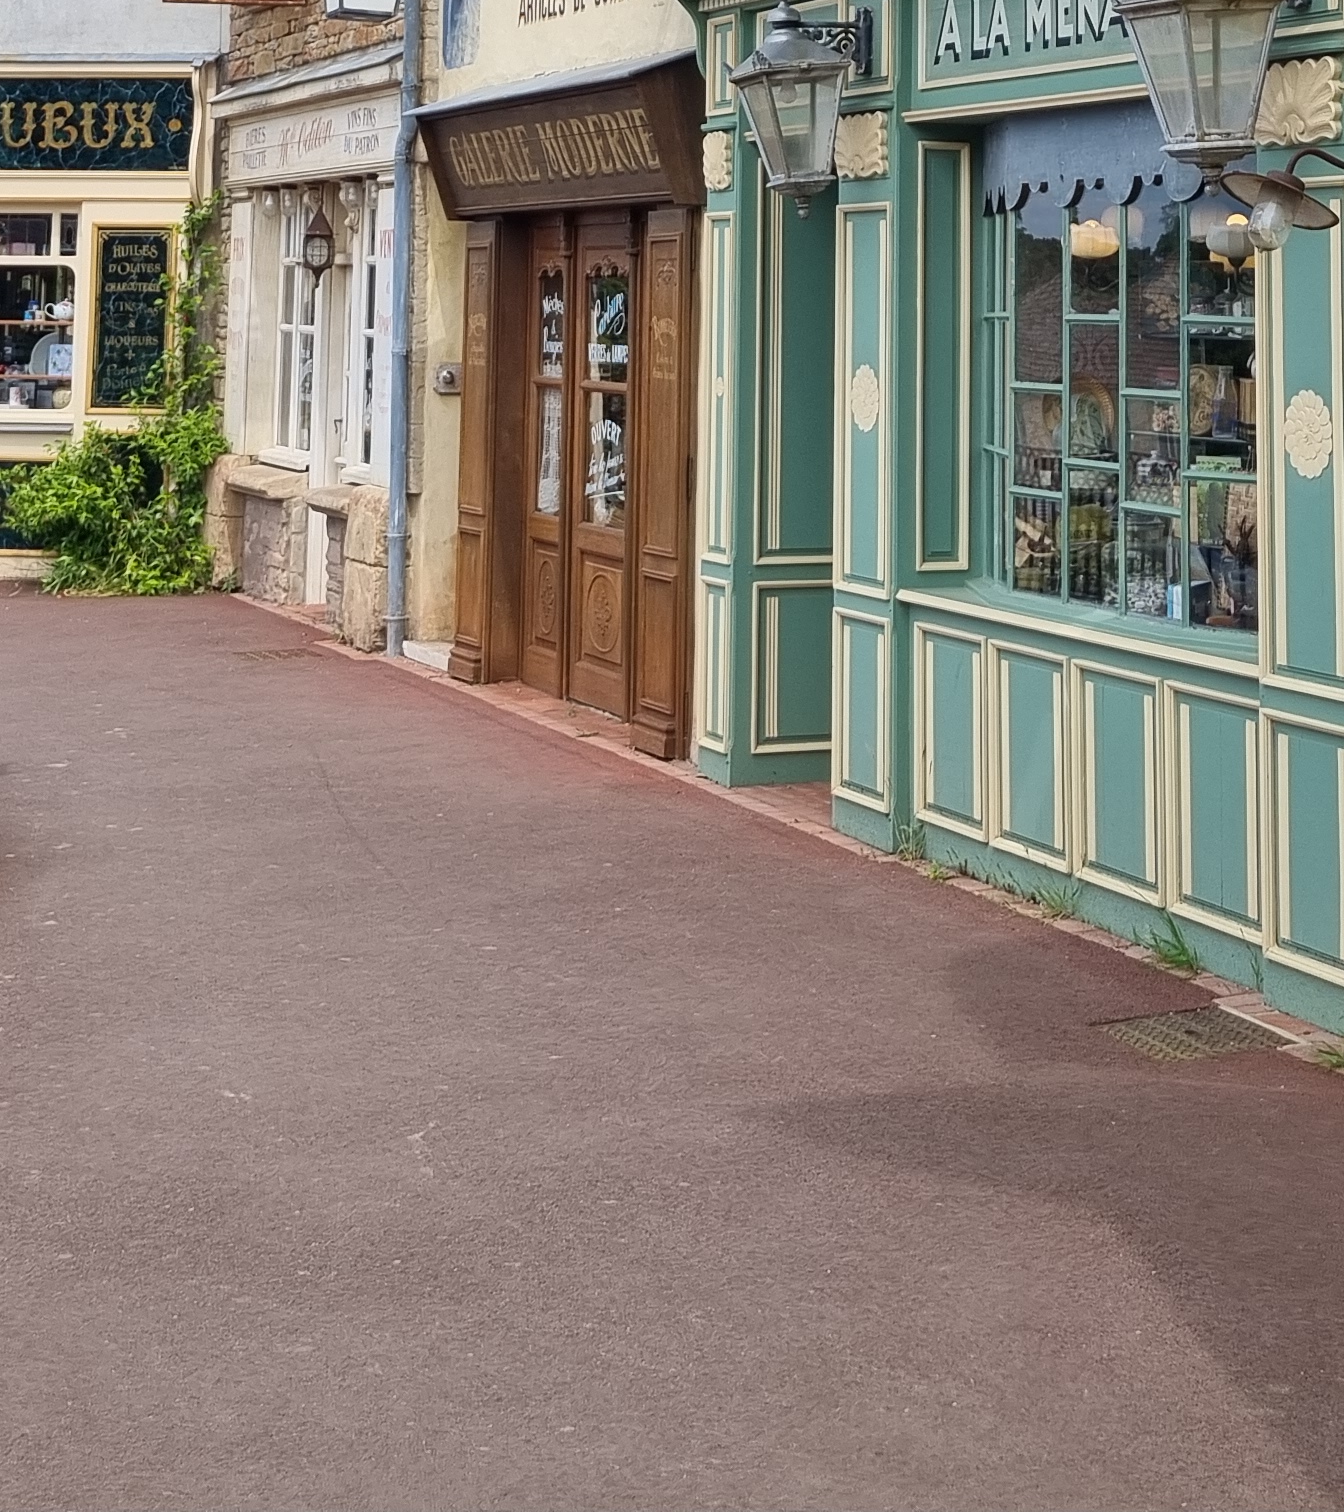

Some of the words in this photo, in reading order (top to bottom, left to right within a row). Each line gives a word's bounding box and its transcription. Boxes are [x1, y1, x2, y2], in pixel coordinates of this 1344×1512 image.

[449, 124, 541, 187] GALERIE
[536, 107, 661, 180] MODERNE
[112, 244, 159, 259] HUILES
[108, 262, 162, 276] D'OLIVES
[105, 335, 159, 348] LIQUEURS
[591, 419, 622, 446] OUVERT
